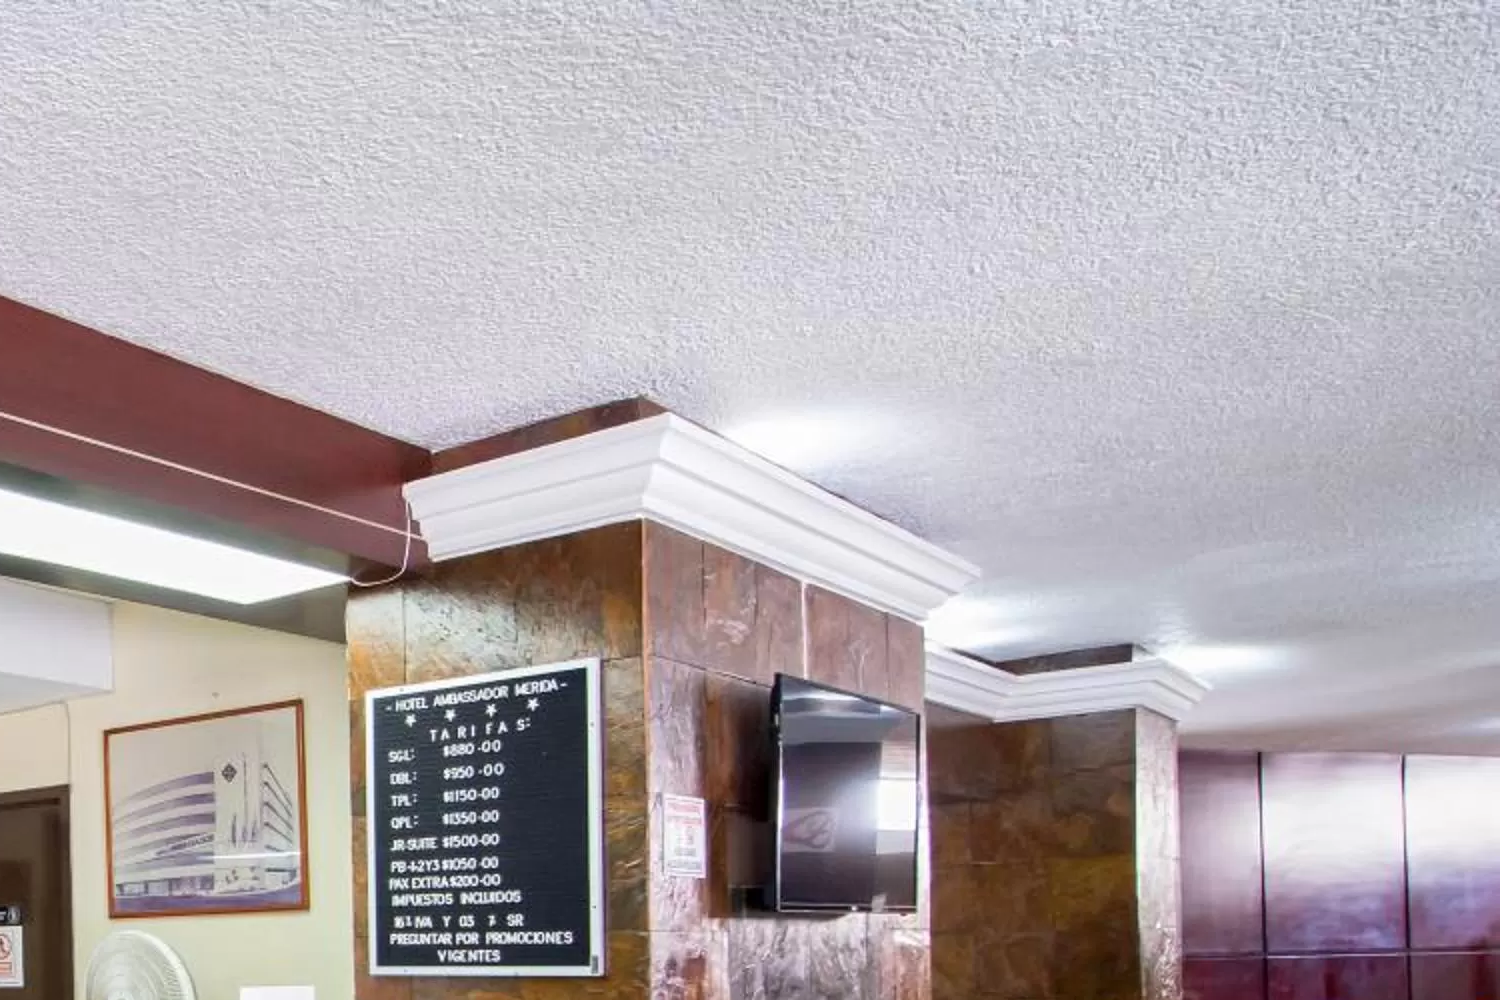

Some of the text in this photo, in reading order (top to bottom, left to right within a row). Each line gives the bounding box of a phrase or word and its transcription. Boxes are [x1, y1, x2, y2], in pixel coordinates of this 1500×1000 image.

[395, 697, 429, 713] HOTEL
[432, 685, 509, 708] AMBASSADOR
[514, 678, 559, 697] MERIDA
[411, 875, 449, 889] EXTRA
[391, 889, 522, 907] IMPUESTOS INCLUIDOS
[442, 915, 451, 927] Y
[389, 930, 574, 945] PREGUNTAR POR PROMOCIONES
[437, 948, 501, 963] VIGENTES
